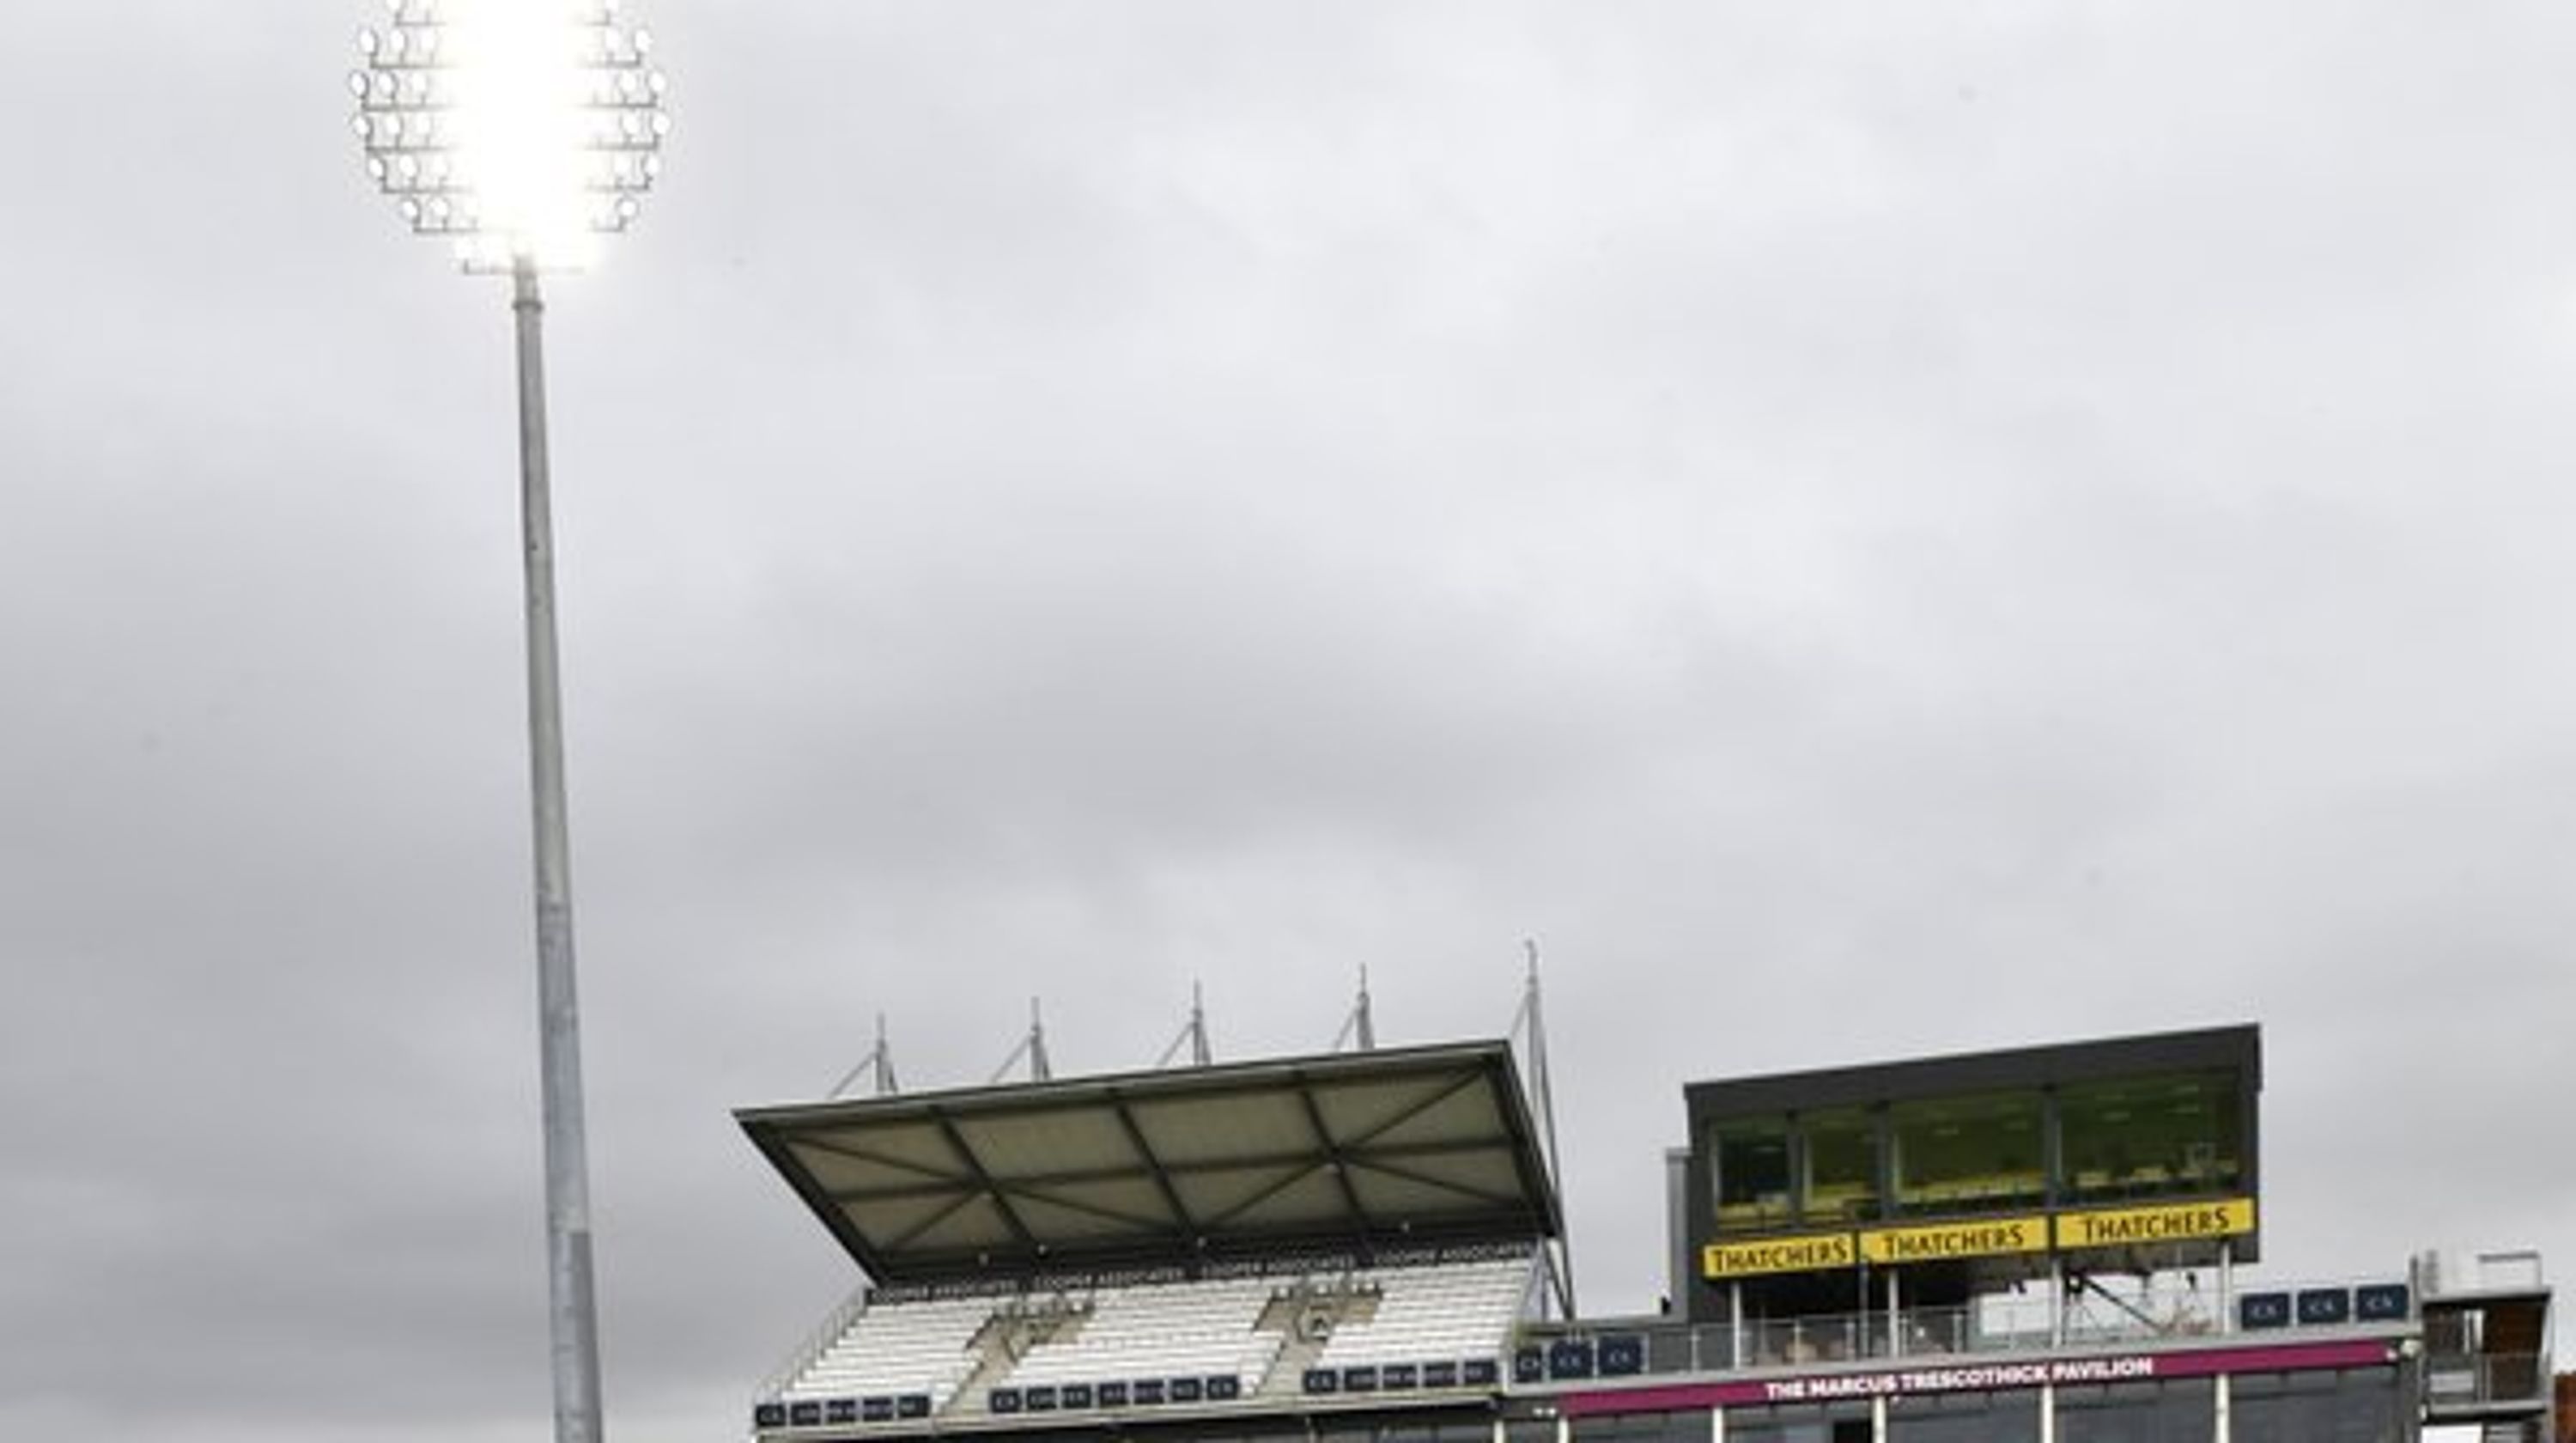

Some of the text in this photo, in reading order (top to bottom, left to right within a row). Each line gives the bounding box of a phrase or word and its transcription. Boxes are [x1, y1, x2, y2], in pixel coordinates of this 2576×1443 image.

[1882, 1225, 2025, 1259] THATCHERS
[2081, 1207, 2232, 1241] THATCHERS
[1710, 1235, 1848, 1273] THATCHERS
[1765, 1356, 2154, 1402] THE MARCUS TRESCOTHICK PAVILION
